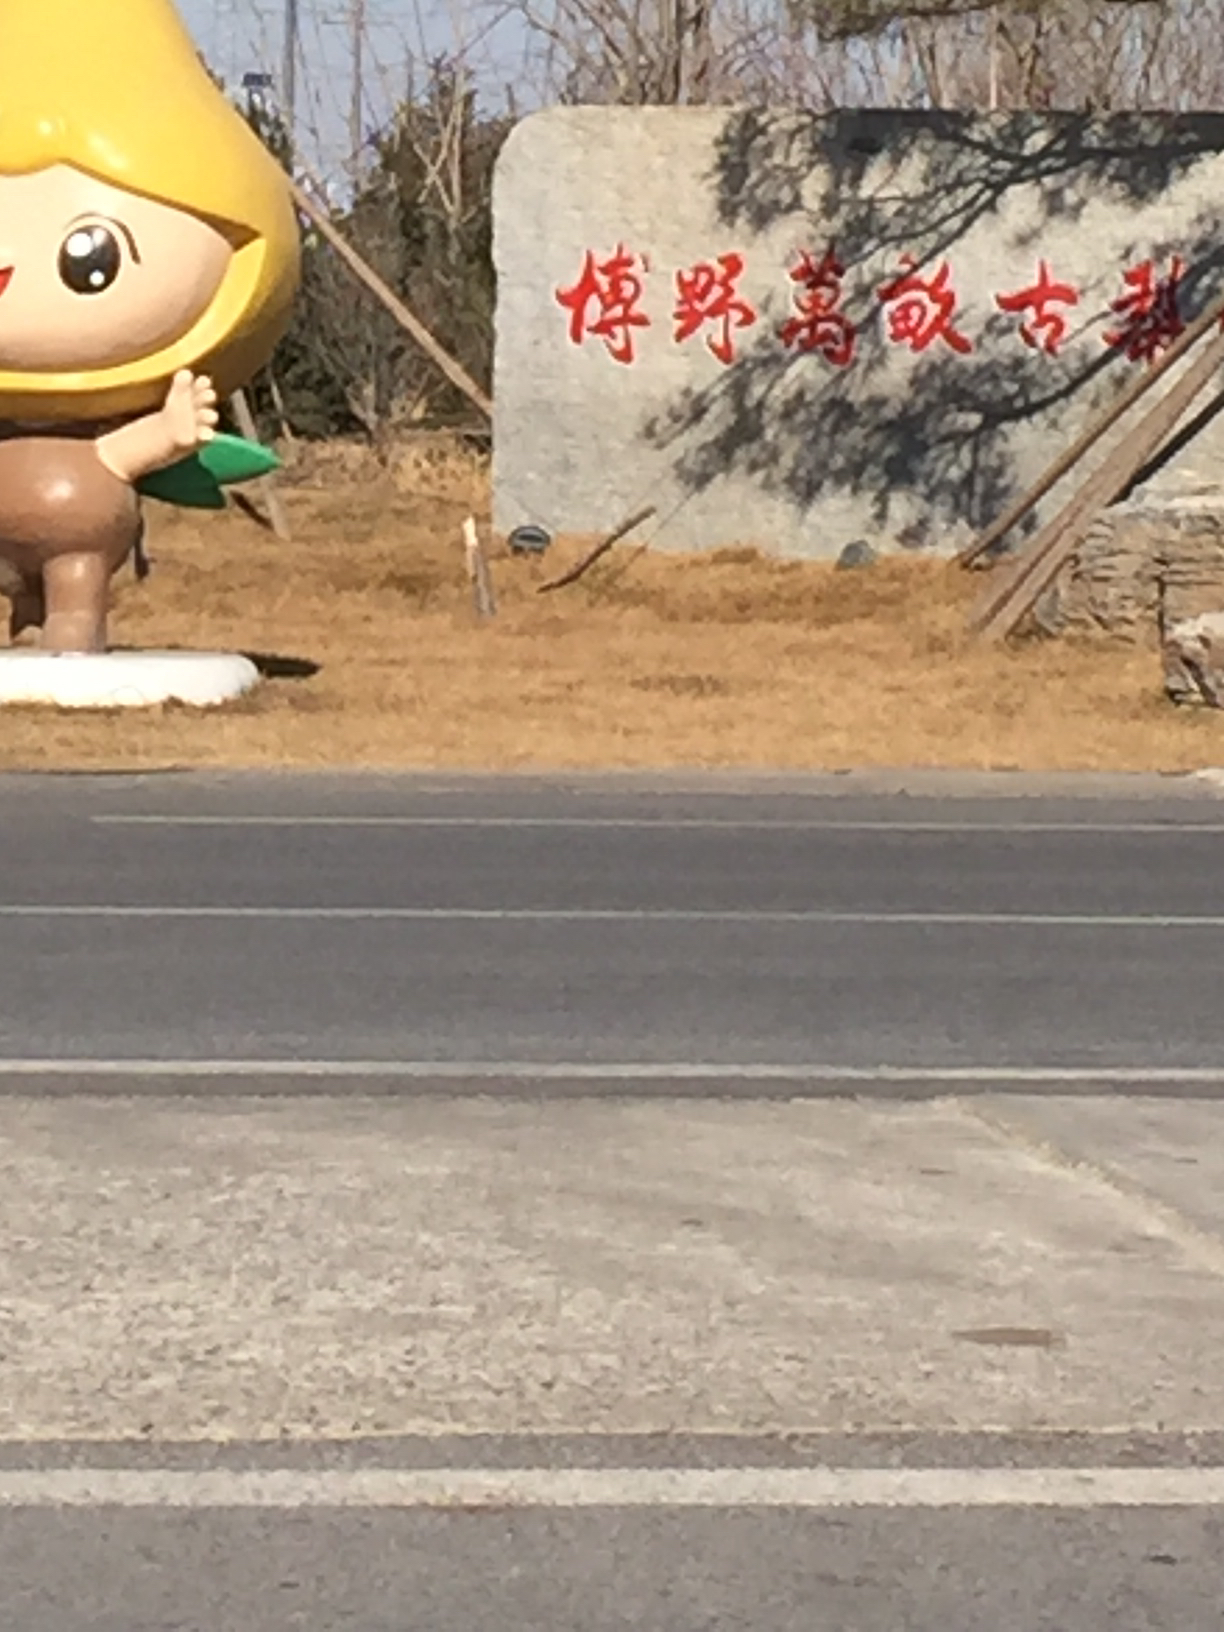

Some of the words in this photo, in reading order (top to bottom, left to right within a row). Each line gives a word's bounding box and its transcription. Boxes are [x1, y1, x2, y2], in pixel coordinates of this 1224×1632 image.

[556, 244, 1224, 364] 博野萬畝古梨
